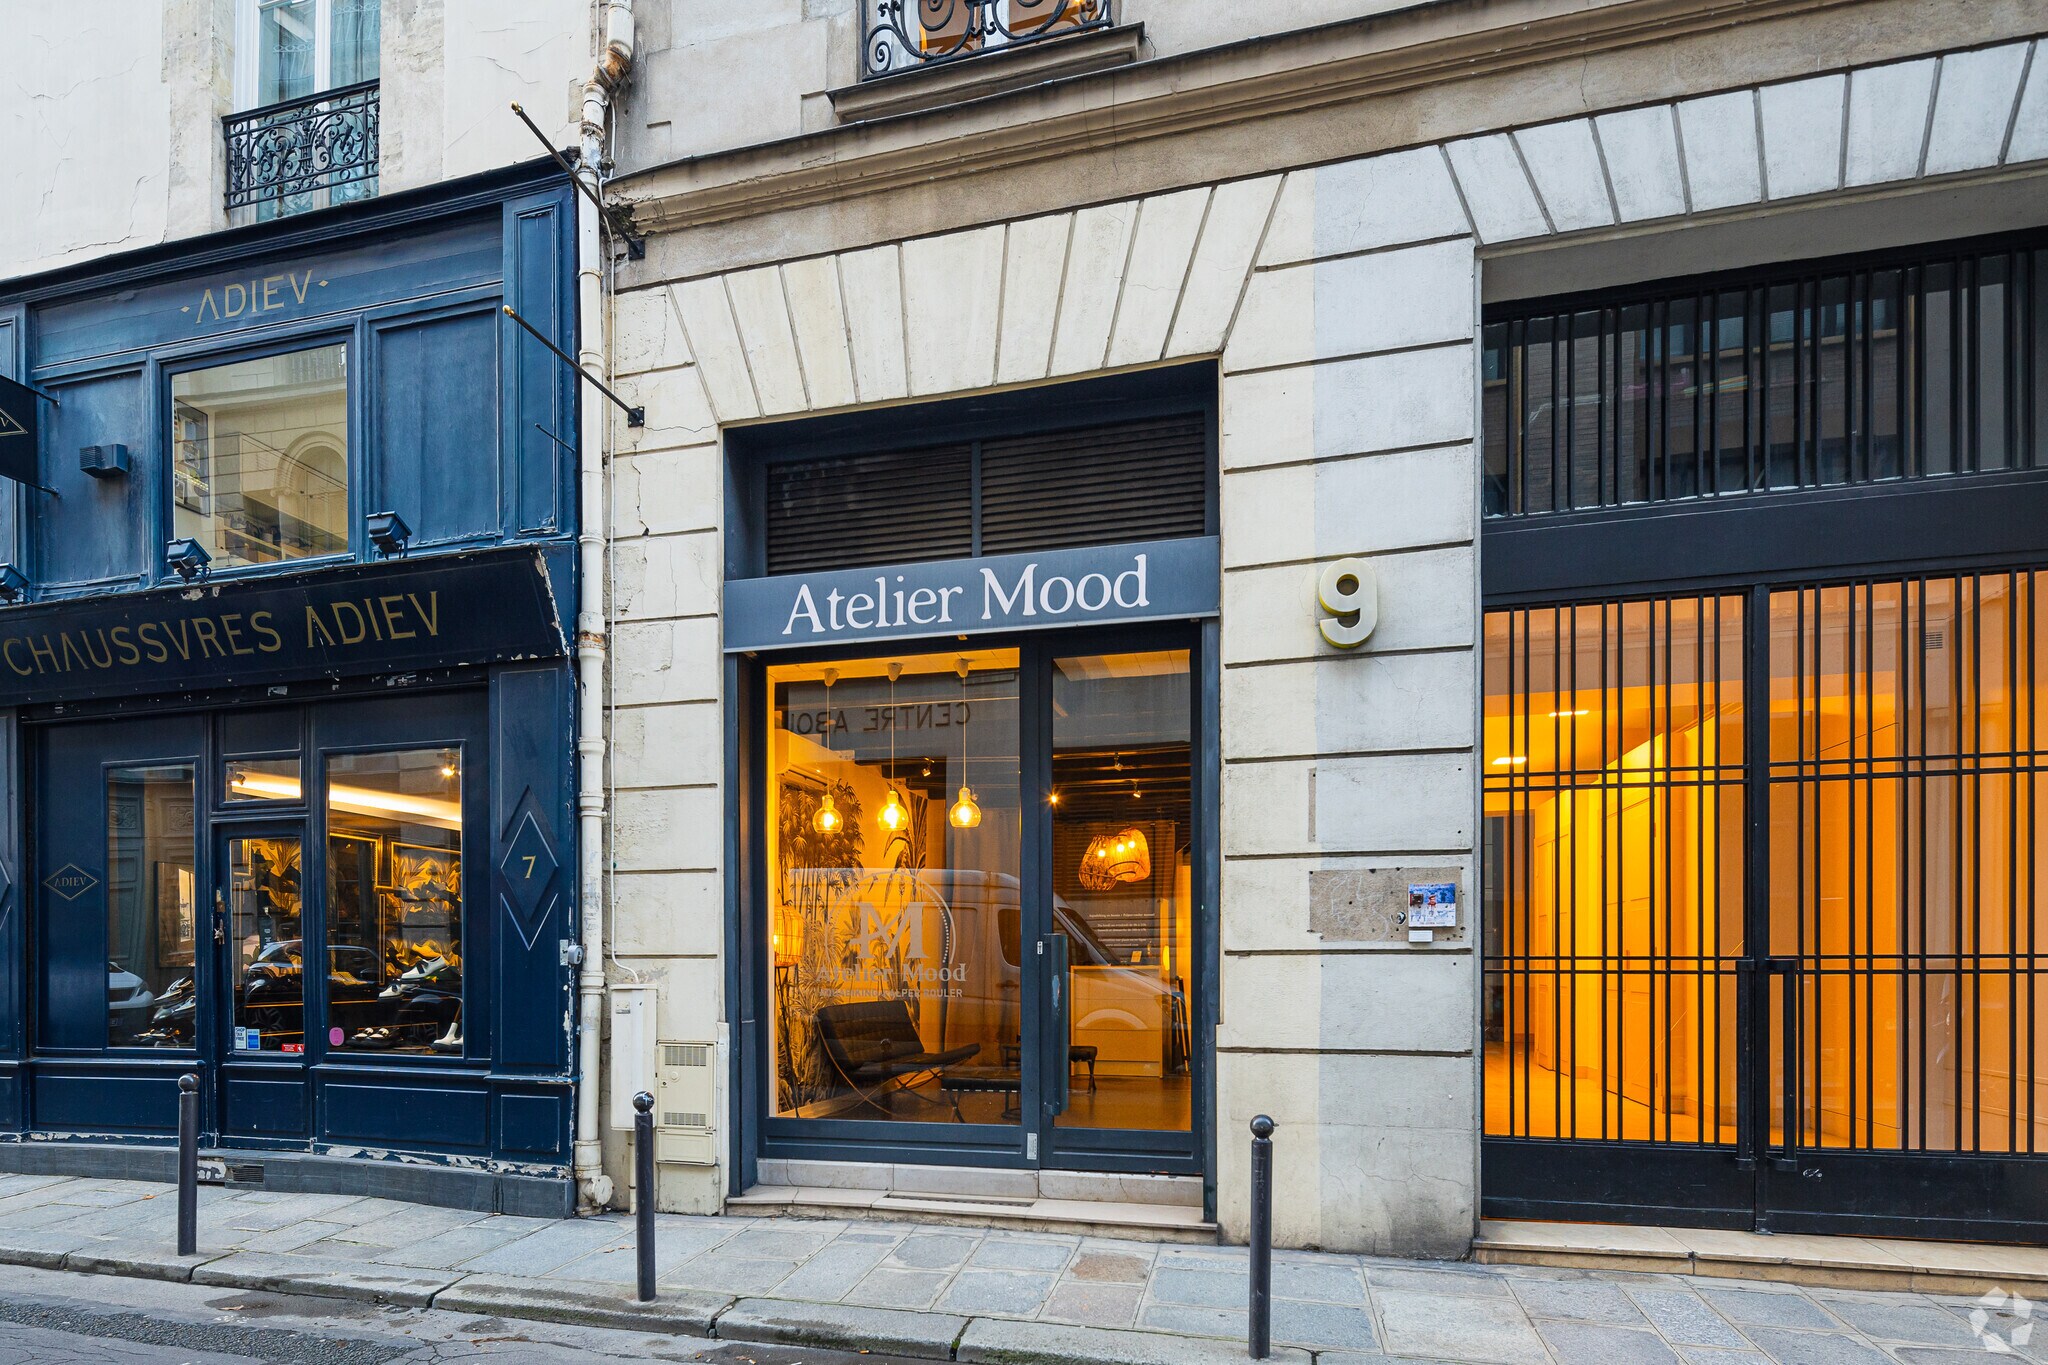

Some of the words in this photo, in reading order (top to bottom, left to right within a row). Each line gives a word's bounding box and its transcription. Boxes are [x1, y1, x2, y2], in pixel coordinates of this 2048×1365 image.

[782, 576, 963, 635] Atelier
[979, 553, 1150, 621] Mood
[1318, 557, 1379, 649] 9
[521, 855, 537, 879] 7
[817, 961, 893, 982] Atelier
[902, 963, 967, 982] Mood
[924, 988, 963, 998] ROULER
